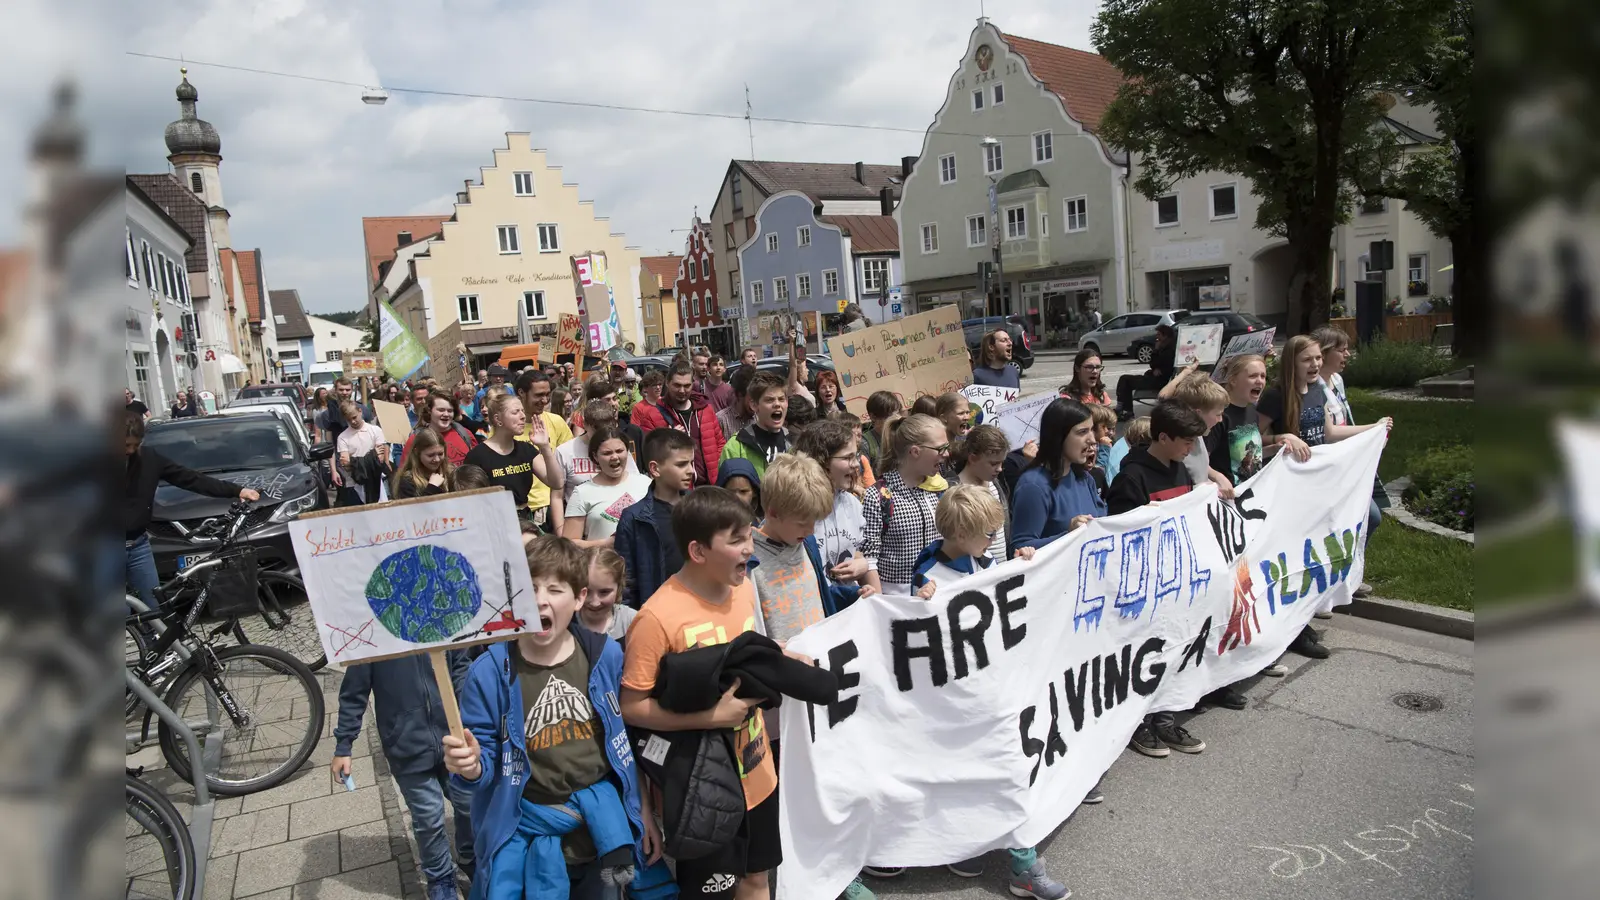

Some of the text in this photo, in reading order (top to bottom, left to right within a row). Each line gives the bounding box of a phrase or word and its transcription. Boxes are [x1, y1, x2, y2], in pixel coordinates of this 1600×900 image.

[562, 314, 582, 332] HÄN
[492, 468, 505, 478] IRIE
[891, 574, 1028, 692] ARE
[1072, 515, 1212, 633] COOL
[1018, 637, 1167, 788] SAVING
[1259, 521, 1363, 616] PLAN
[526, 696, 592, 738] ROCKY
[526, 718, 596, 751] OUNTAIN
[702, 875, 736, 893] adida
